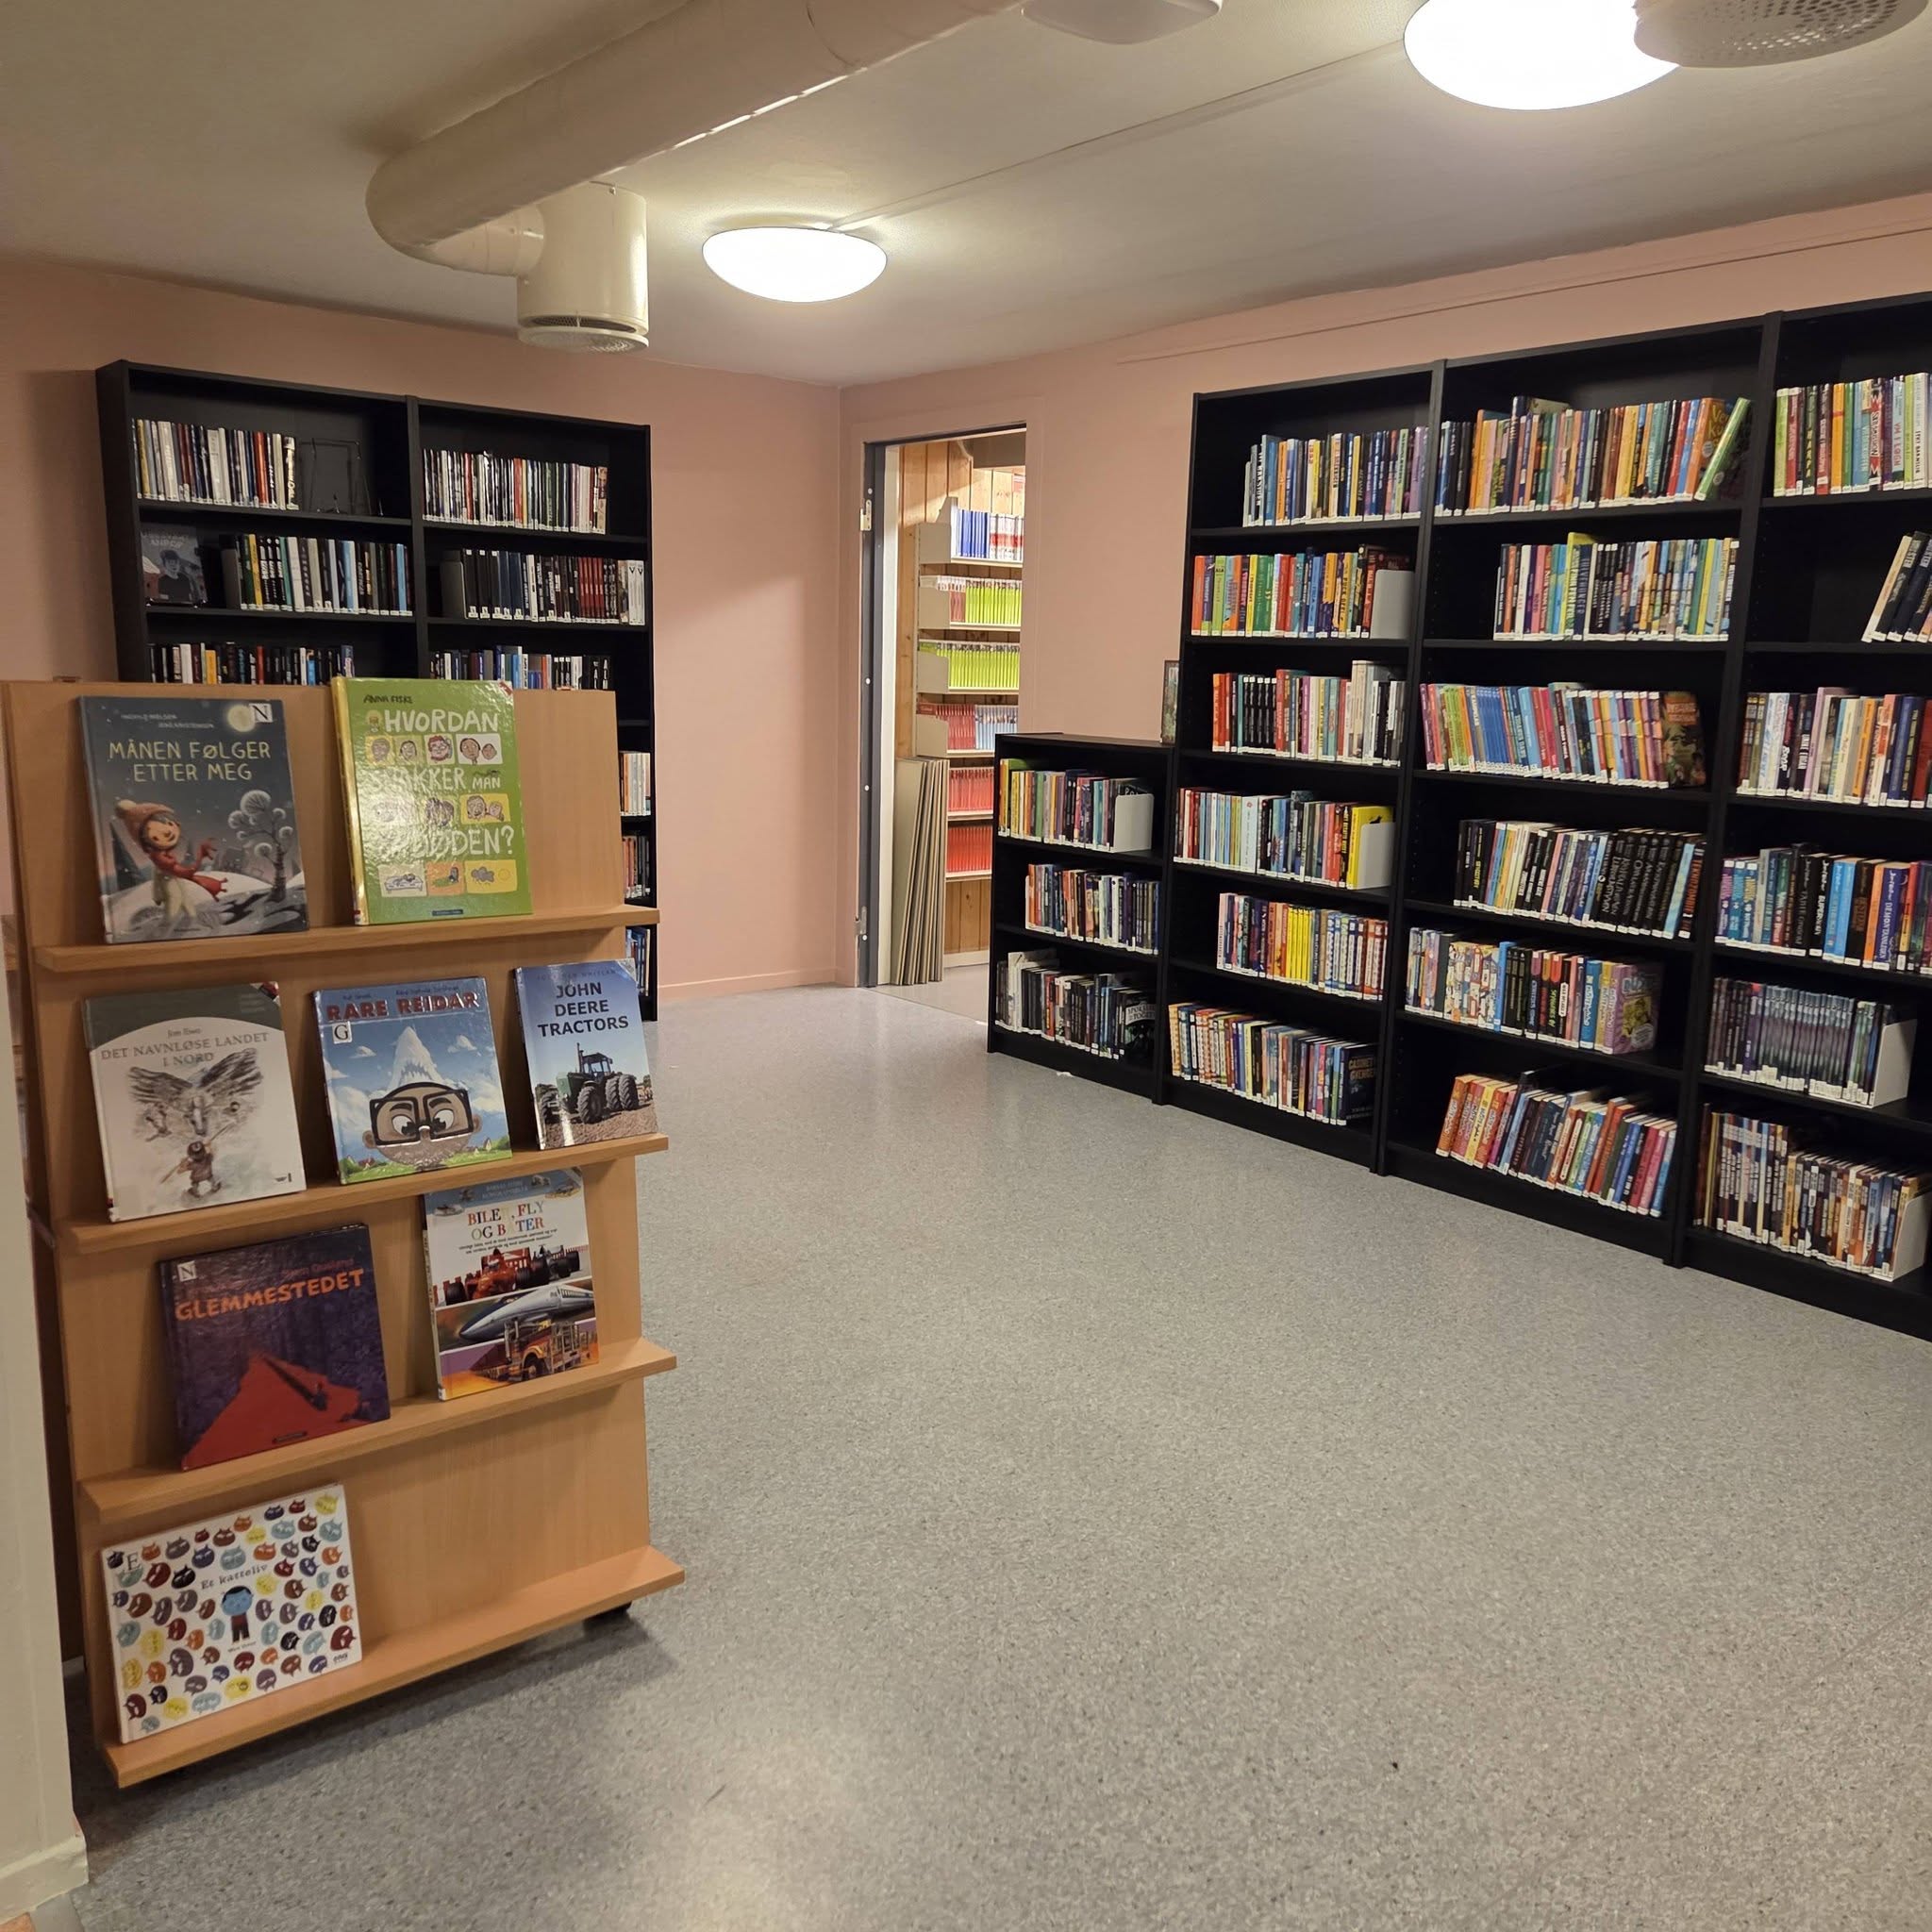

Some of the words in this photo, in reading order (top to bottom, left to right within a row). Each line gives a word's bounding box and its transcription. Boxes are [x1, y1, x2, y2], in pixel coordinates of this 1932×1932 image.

[252, 705, 268, 720] N
[384, 708, 498, 733] HVORDAN
[108, 739, 181, 759] MÅNEN
[189, 741, 272, 759] FØLGER
[133, 763, 198, 782] ETTER
[208, 762, 253, 781] MEG
[472, 776, 501, 790] MAN
[555, 981, 603, 999] JOHN
[326, 1000, 390, 1021] RARE
[396, 991, 480, 1014] REIDAR
[554, 999, 609, 1017] DEERE
[334, 1024, 349, 1041] G
[537, 1016, 629, 1038] TRACTORS
[101, 1047, 128, 1060] DET
[133, 1038, 211, 1057] NAVNLØSE
[215, 1032, 270, 1048] LANDET
[173, 1051, 214, 1066] NORD
[518, 1200, 544, 1218] FLY
[472, 1225, 493, 1241] OG
[175, 1268, 365, 1322] GLEMMESTEDET
[126, 1553, 142, 1572] E
[219, 1564, 269, 1587] katteliv
